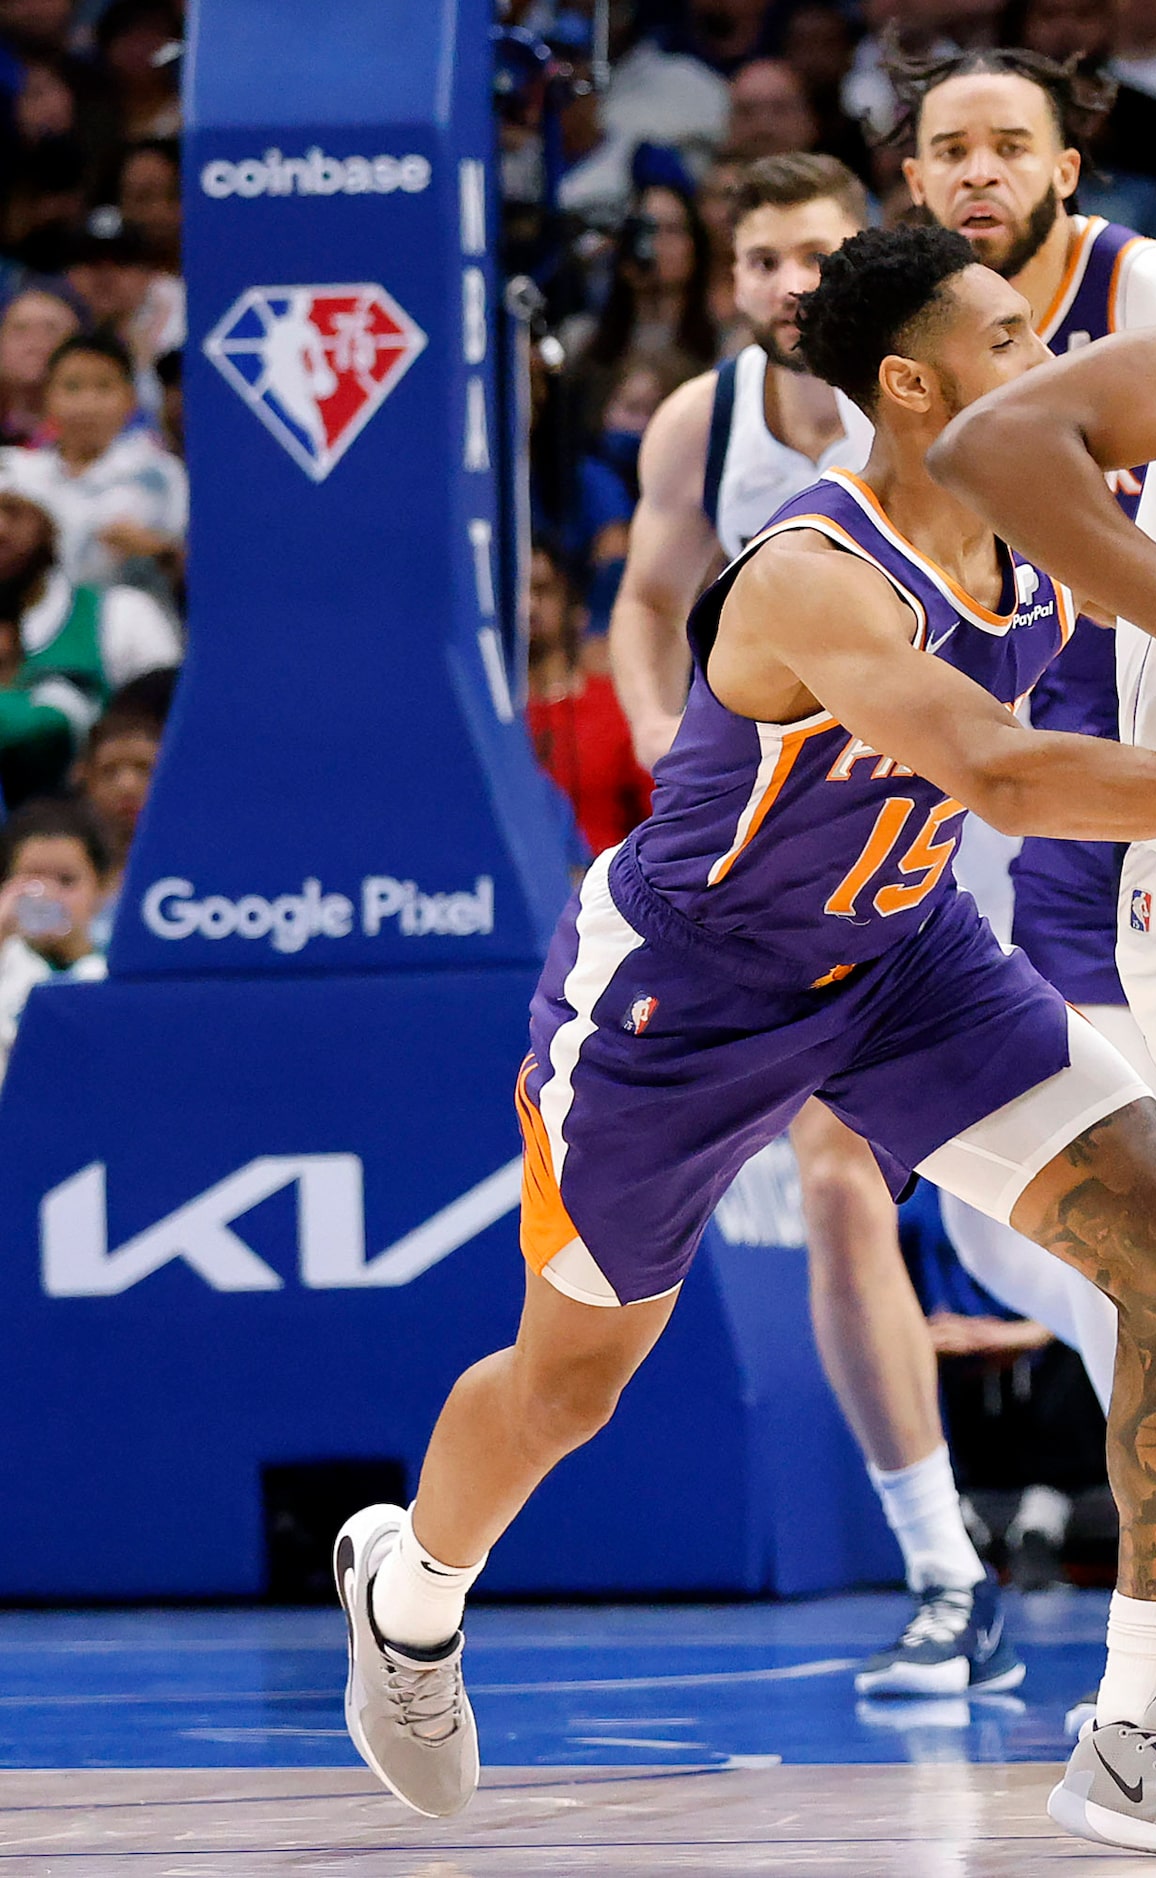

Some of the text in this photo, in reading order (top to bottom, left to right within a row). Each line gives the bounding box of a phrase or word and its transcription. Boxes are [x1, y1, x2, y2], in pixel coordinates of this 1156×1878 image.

[201, 146, 432, 199] coinbase
[1012, 600, 1054, 630] PayPal
[823, 796, 969, 918] 15
[142, 874, 495, 954] Google Pixel
